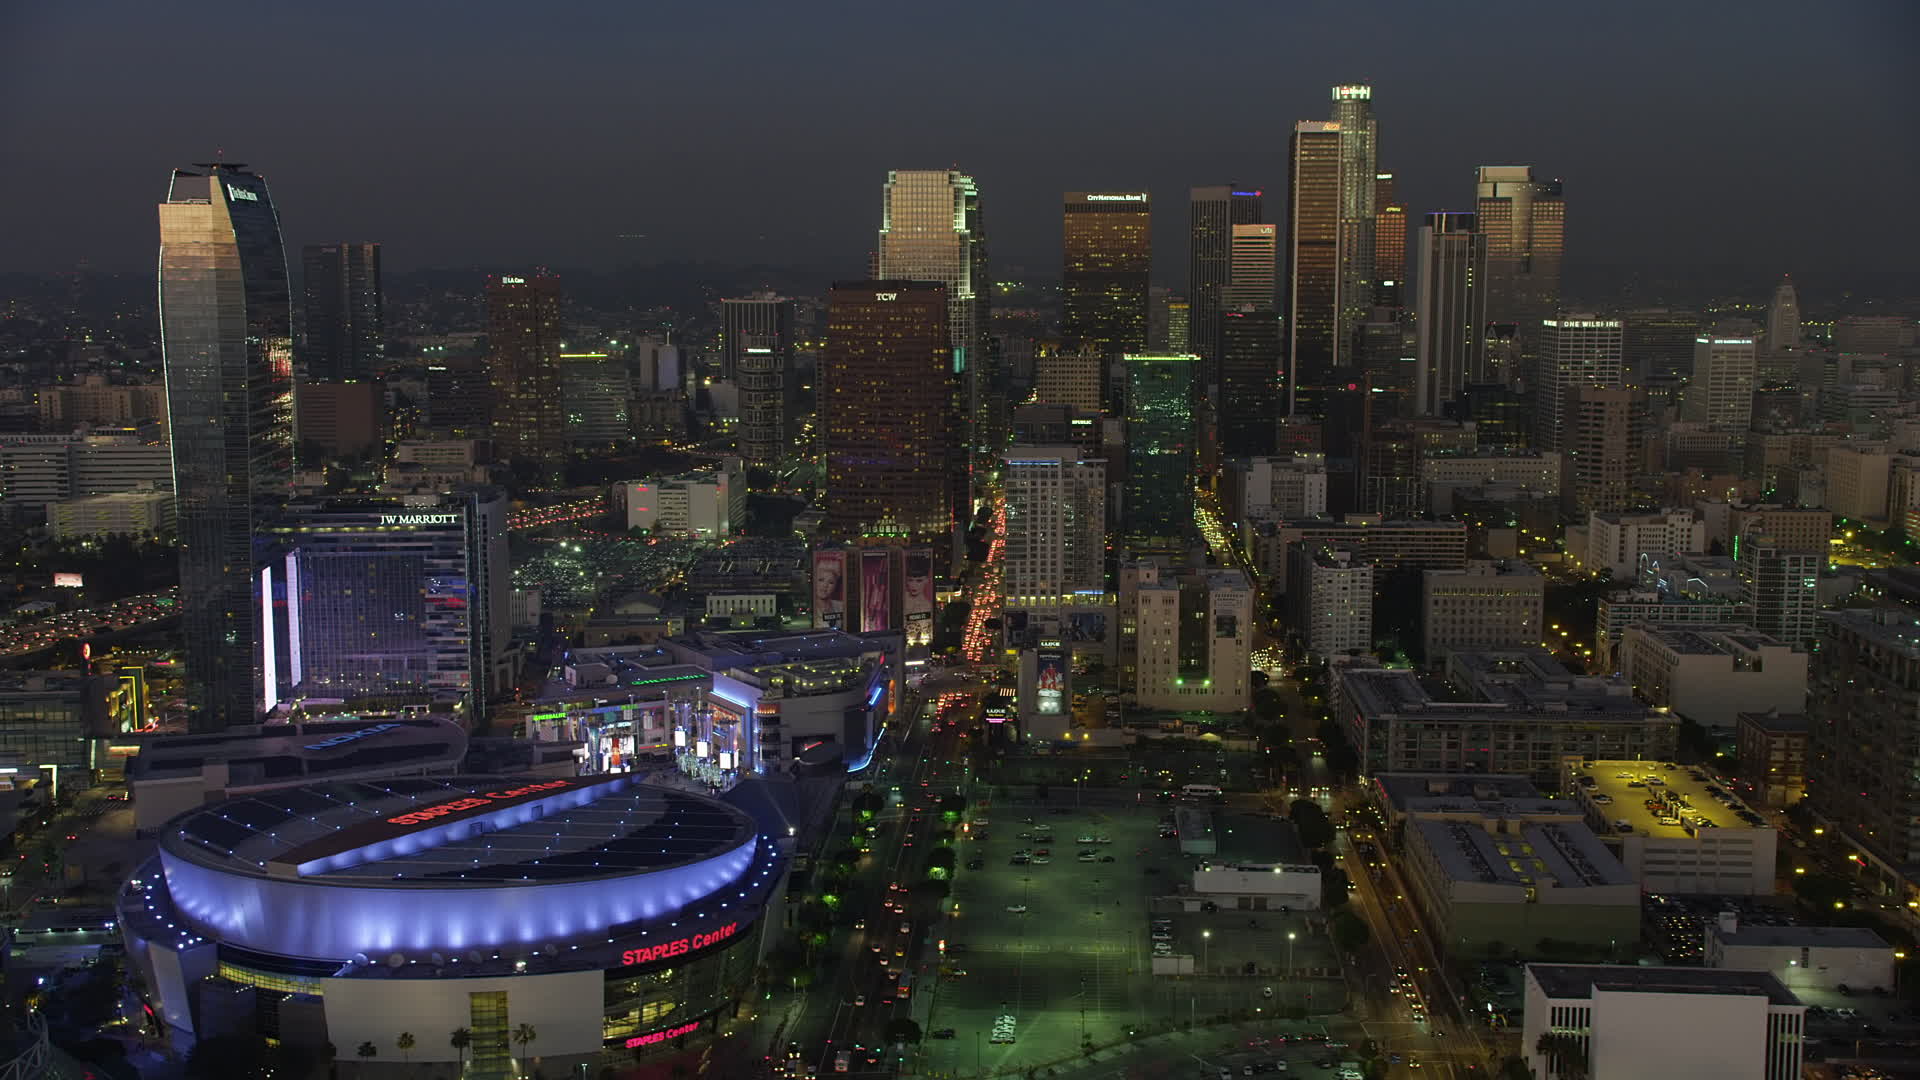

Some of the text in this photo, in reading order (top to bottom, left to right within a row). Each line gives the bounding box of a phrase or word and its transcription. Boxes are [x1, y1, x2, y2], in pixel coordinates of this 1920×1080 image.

[875, 293, 897, 301] TCW
[380, 514, 457, 525] JW MARRIOTT
[303, 723, 401, 750] NOKIA
[386, 780, 576, 825] STAPLES Center
[622, 921, 737, 966] STAPLES Center
[625, 1021, 700, 1049] STAPLES Center
